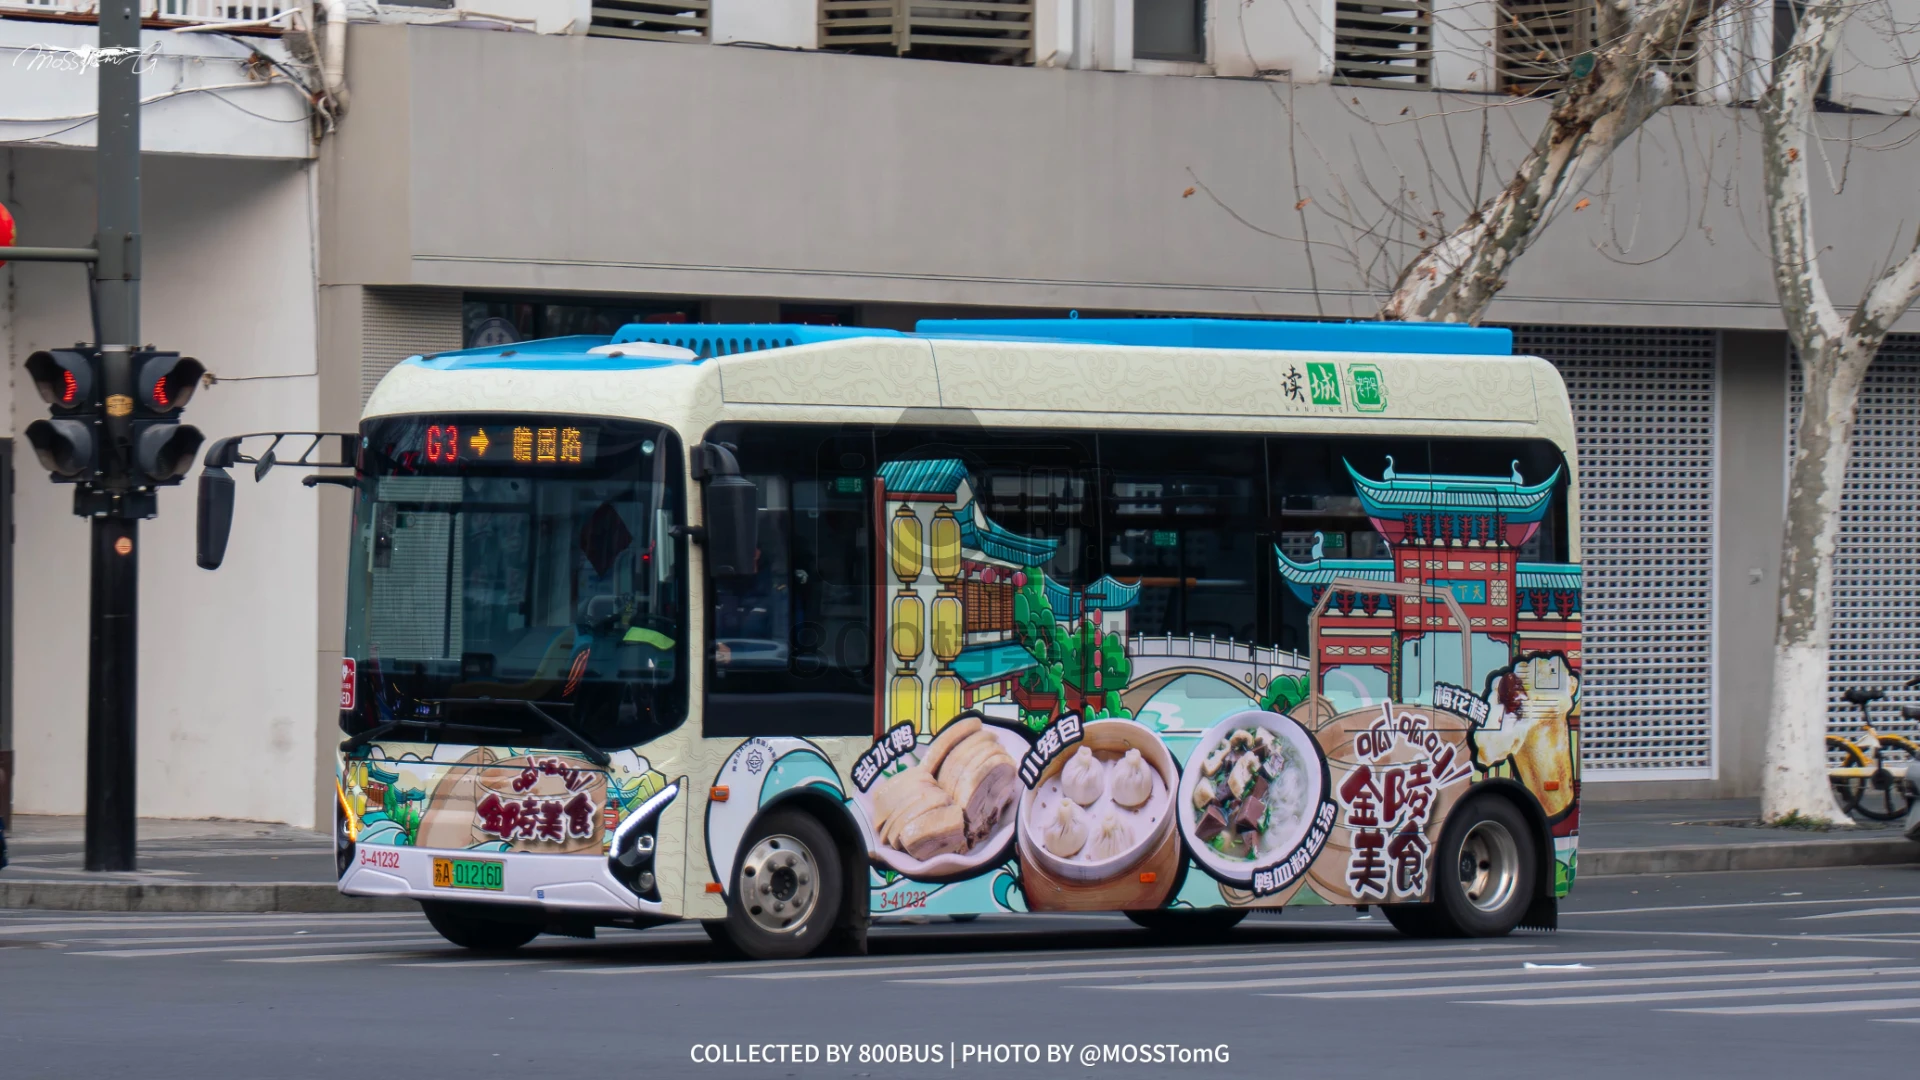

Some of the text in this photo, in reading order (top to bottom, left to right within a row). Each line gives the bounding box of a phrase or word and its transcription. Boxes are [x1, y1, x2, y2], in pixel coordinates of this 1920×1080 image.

[1281, 363, 1341, 403] 读城
[427, 425, 458, 462] G3
[340, 691, 351, 705] ED
[1433, 683, 1490, 726] 梅花糕
[853, 724, 914, 787] 盐水鸭
[1021, 715, 1082, 785] 小笼包
[1356, 700, 1460, 780] 呱呱叫
[477, 792, 594, 840] 金陵美食
[360, 849, 400, 868] 3-41232
[1254, 801, 1337, 892] 鸭血粉丝汤
[880, 891, 927, 909] 3-41232
